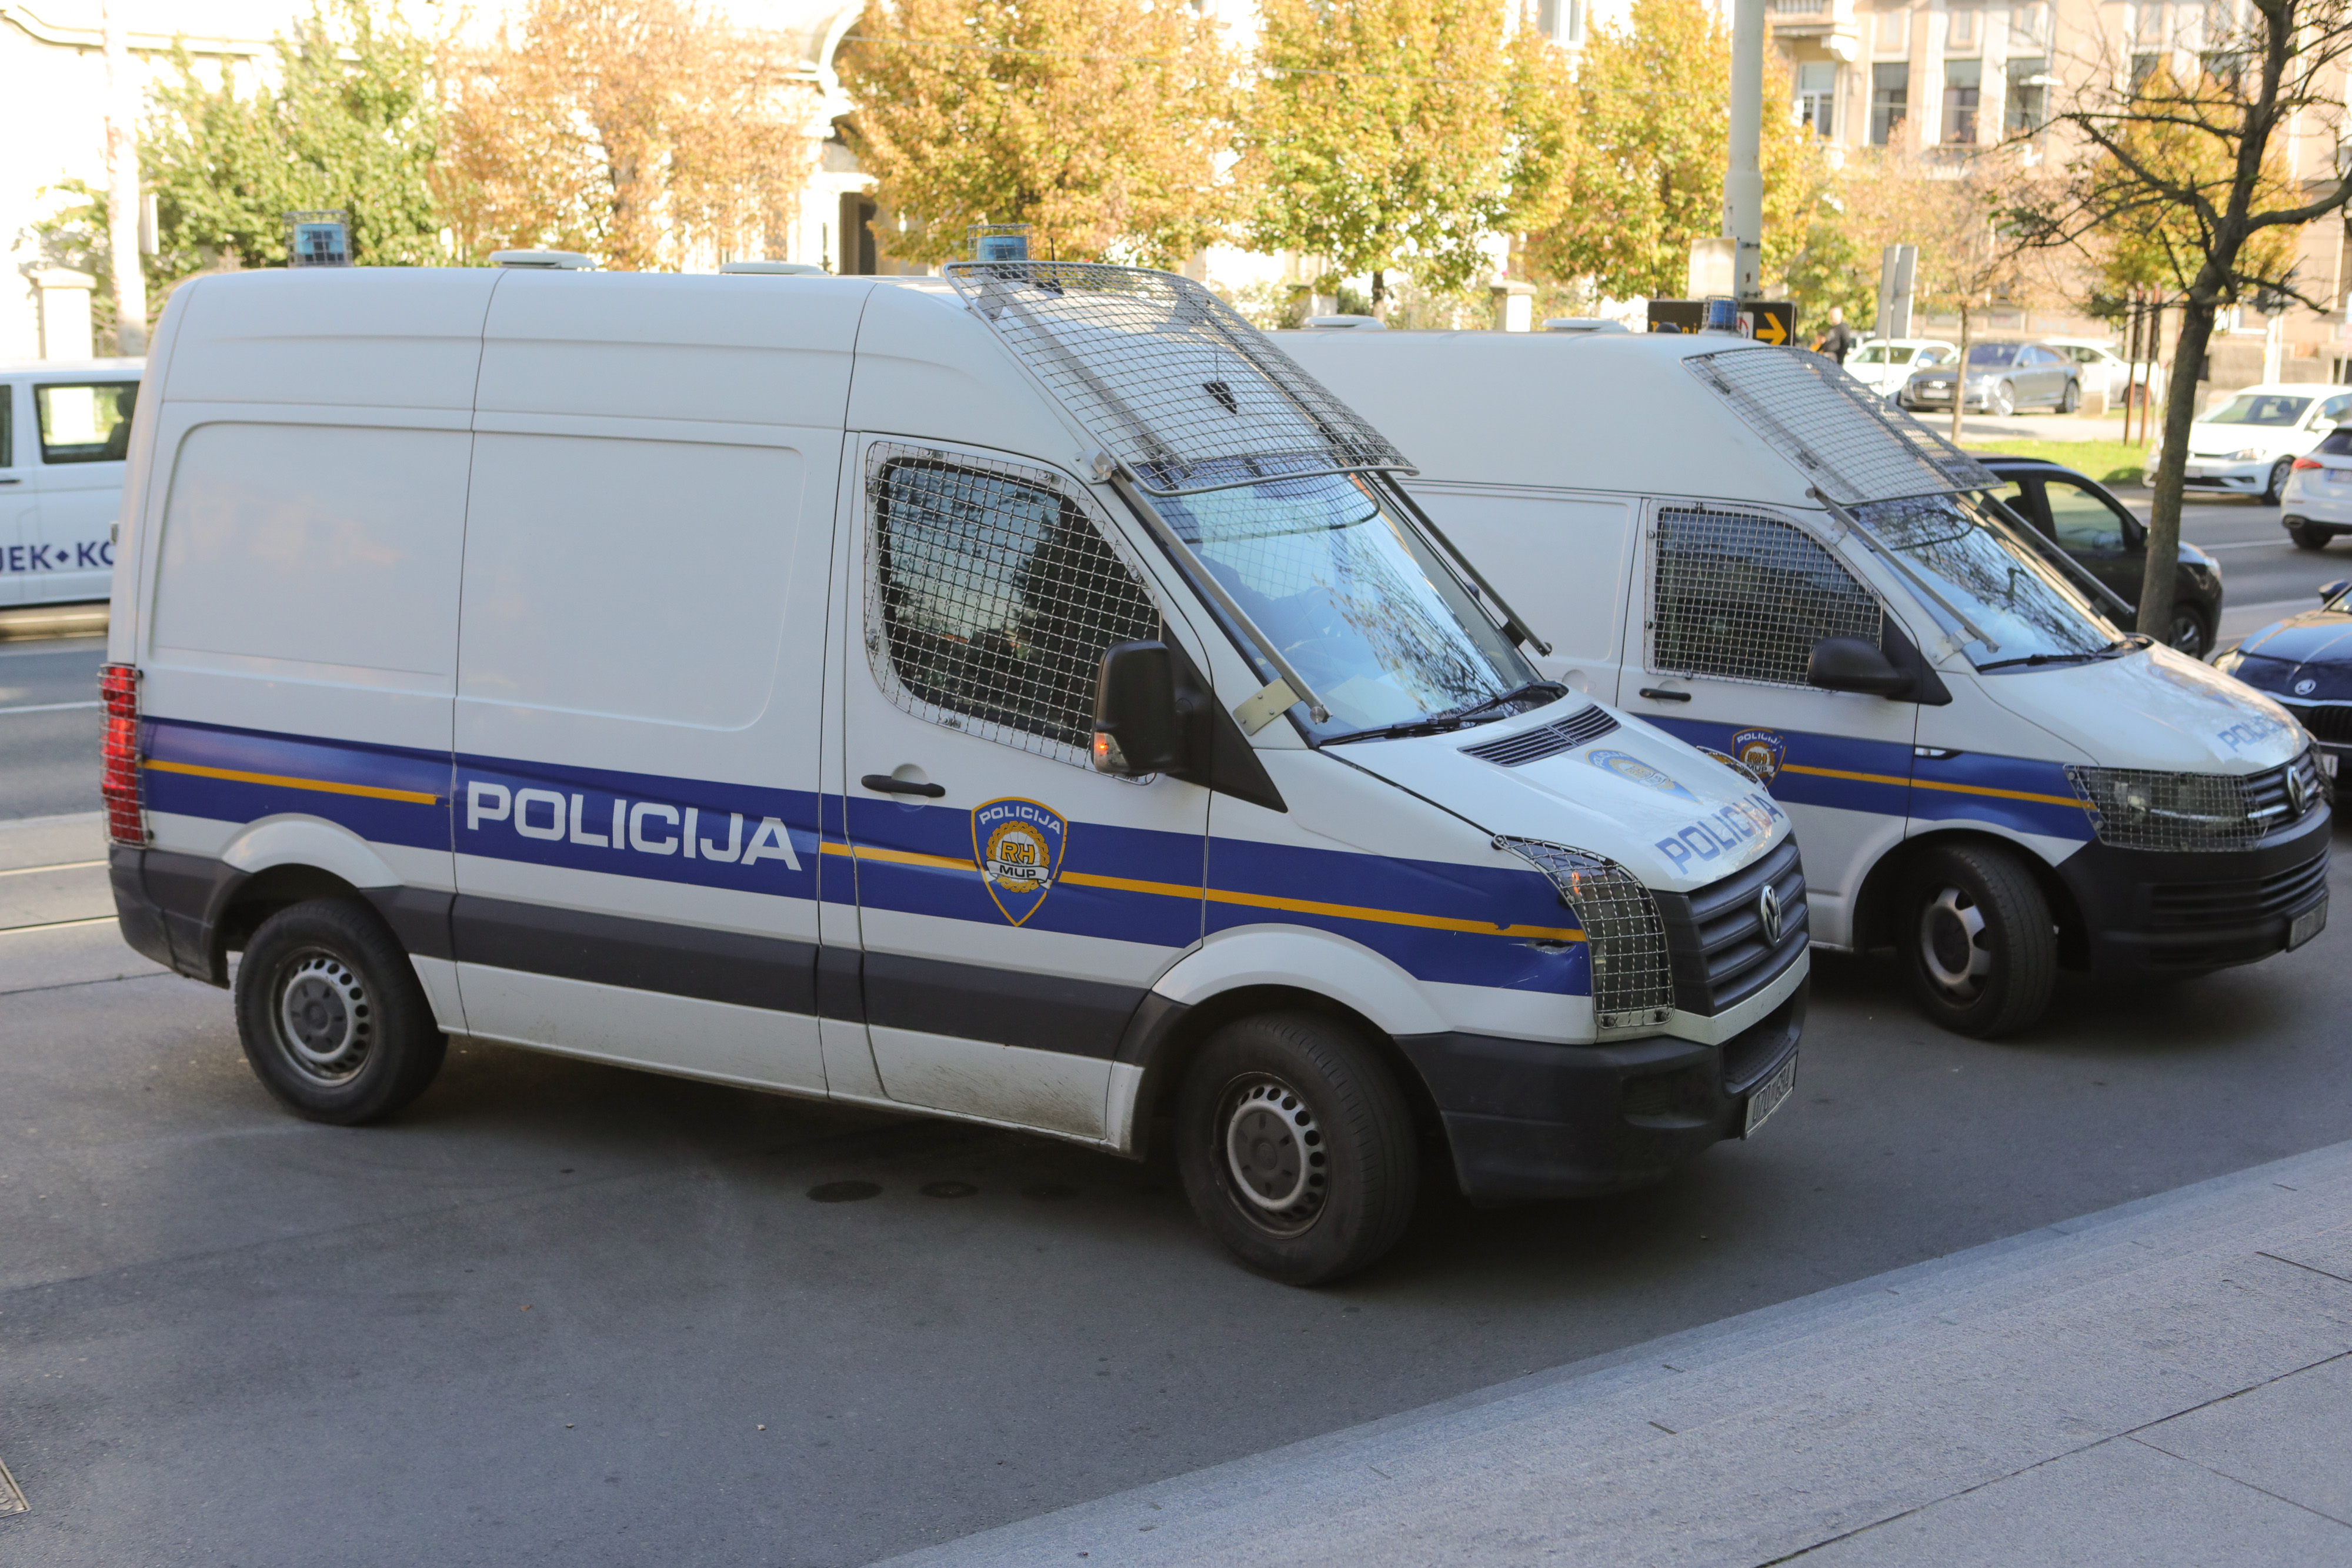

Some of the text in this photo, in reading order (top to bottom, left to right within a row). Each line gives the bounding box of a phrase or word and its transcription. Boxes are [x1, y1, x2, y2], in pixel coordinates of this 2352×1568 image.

[467, 780, 802, 872] POLICIJA
[979, 805, 1060, 835] POLICIJA
[1654, 793, 1784, 876] POLICIJA
[1000, 840, 1036, 865] RH
[999, 865, 1036, 878] MUP
